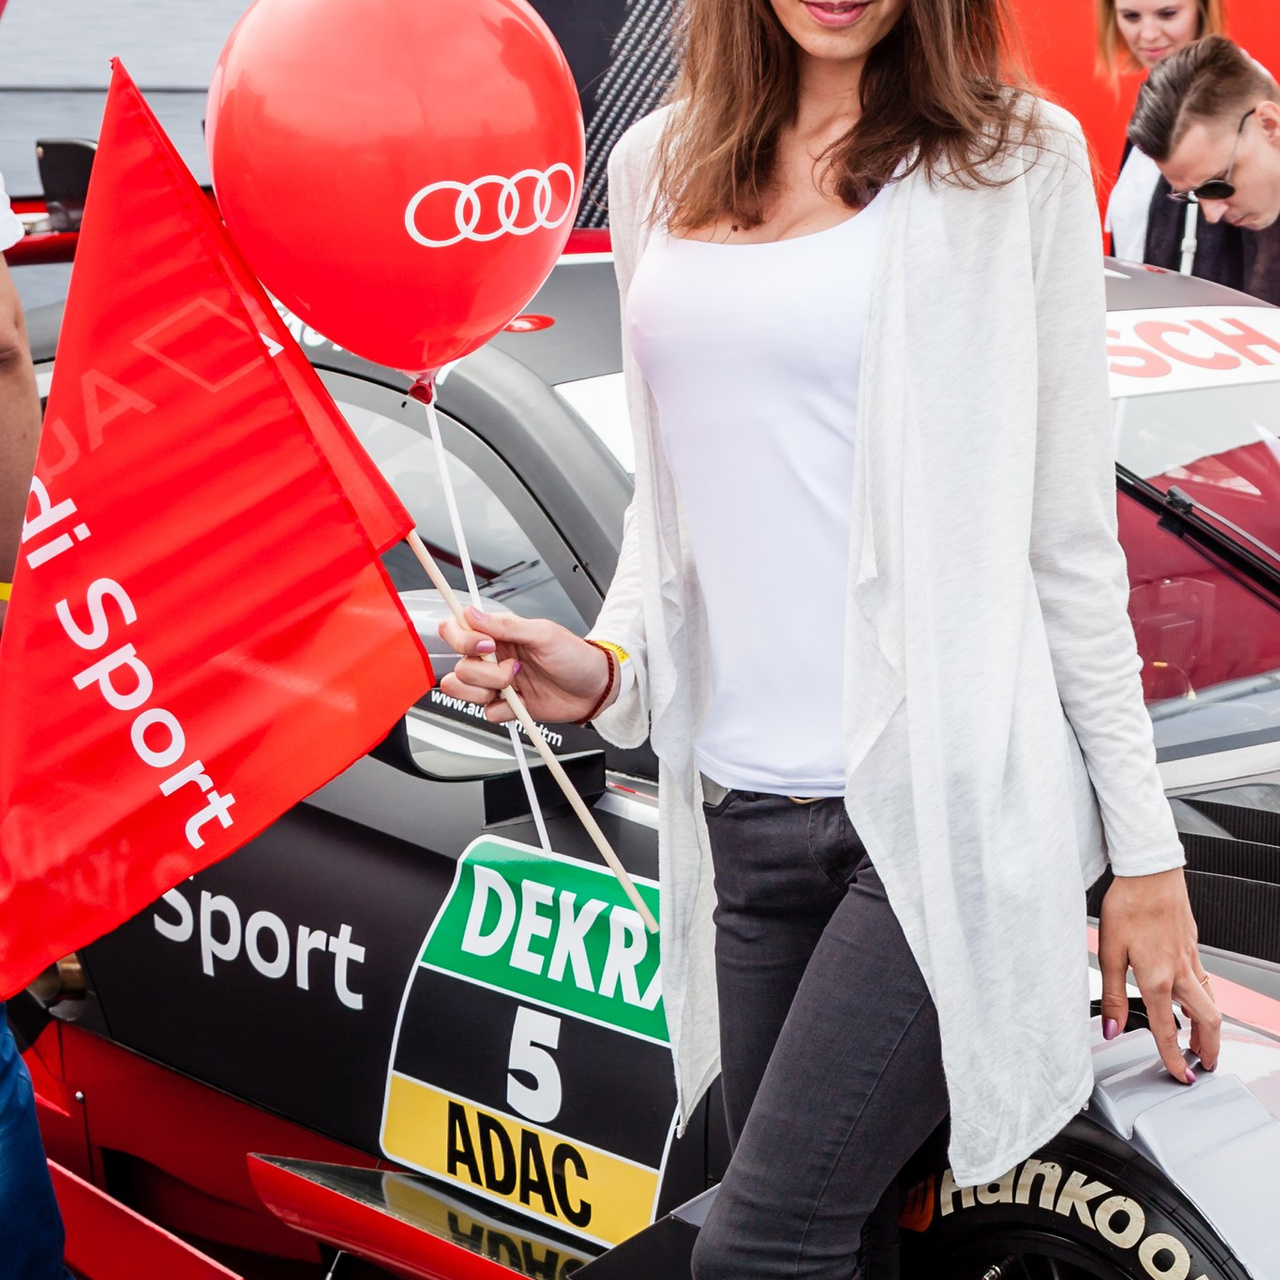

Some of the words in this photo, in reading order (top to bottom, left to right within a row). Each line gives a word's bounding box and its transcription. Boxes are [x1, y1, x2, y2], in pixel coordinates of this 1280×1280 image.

[56, 577, 237, 850] Sport
[506, 1006, 563, 1123] 5
[446, 1101, 592, 1227] ADAC
